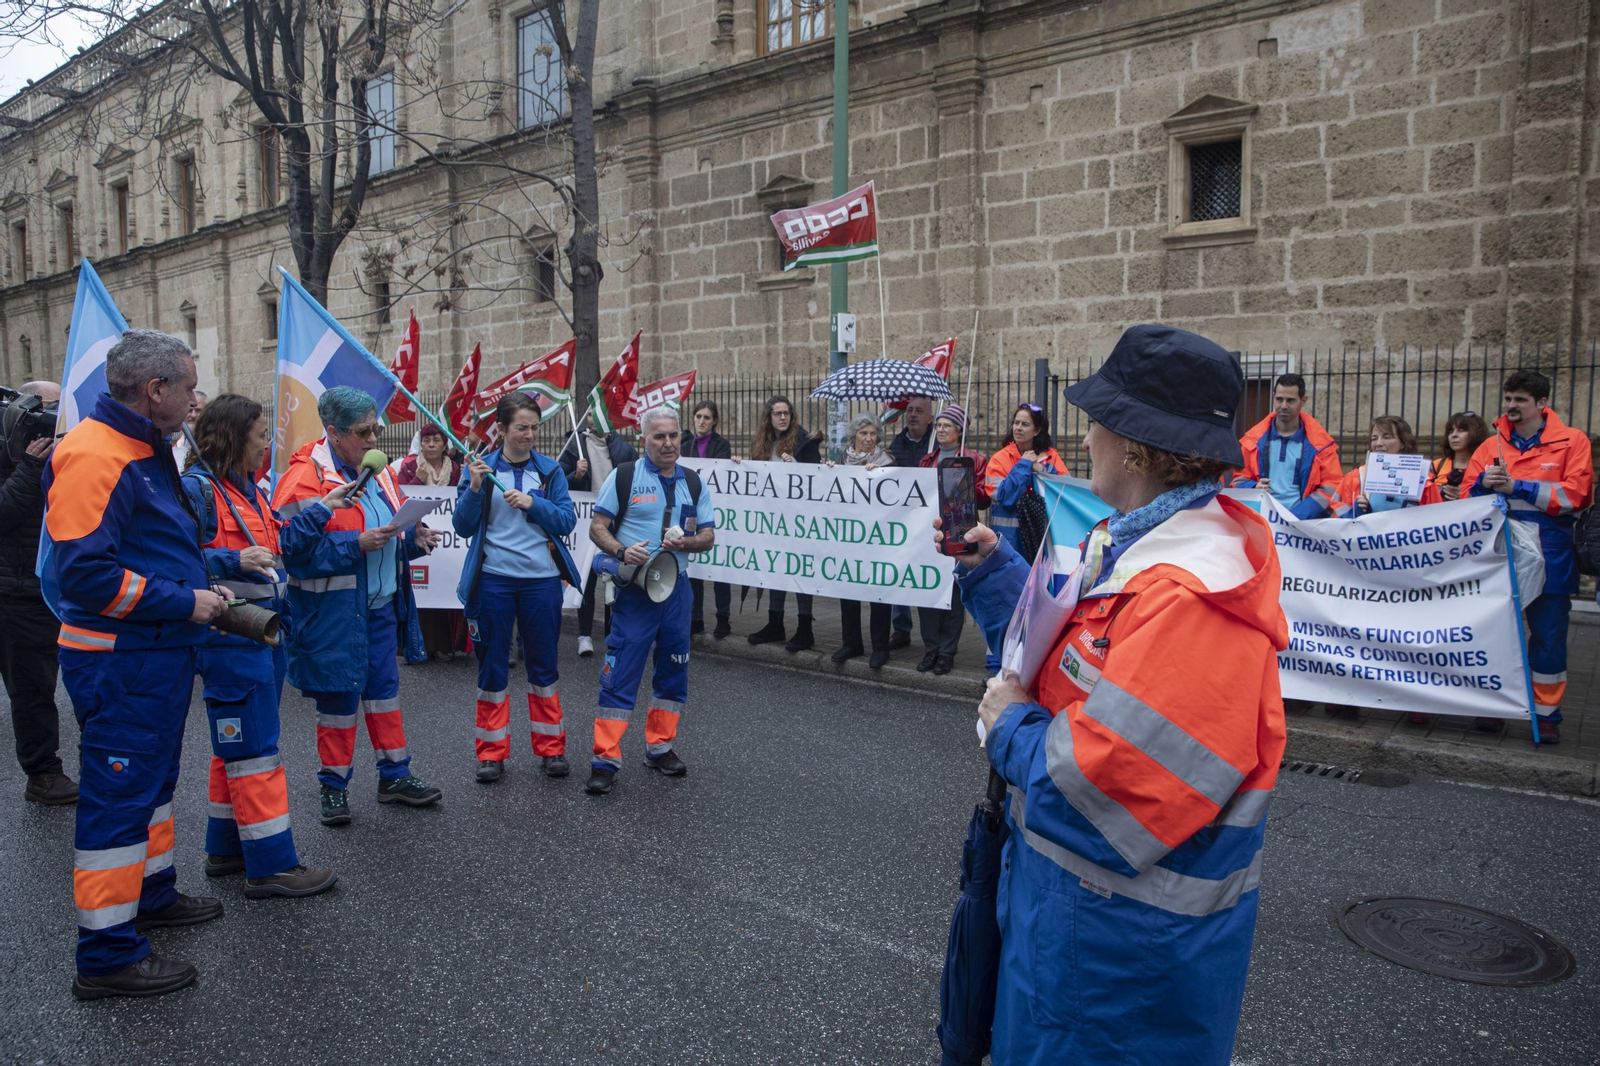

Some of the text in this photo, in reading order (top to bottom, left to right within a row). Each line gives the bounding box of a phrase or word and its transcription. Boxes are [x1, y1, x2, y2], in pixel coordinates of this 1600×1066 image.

[632, 486, 657, 495] SUAP
[786, 473, 930, 508] BLANCA
[711, 507, 908, 547] OR UNA SANIDAD
[1341, 537, 1354, 552] Y
[1357, 517, 1494, 551] EMERGENCIAS
[1449, 540, 1484, 560] SAS
[688, 544, 941, 591] BLICA Y DE CALIDAD
[1282, 576, 1481, 603] REGULARIZACIÓN YA!!!
[1293, 621, 1474, 645] MISMAS FUNCIONES
[1287, 637, 1488, 667] MISMAS CONDICIONES
[1277, 655, 1503, 691] MISMAS RETRIBUCIONES
